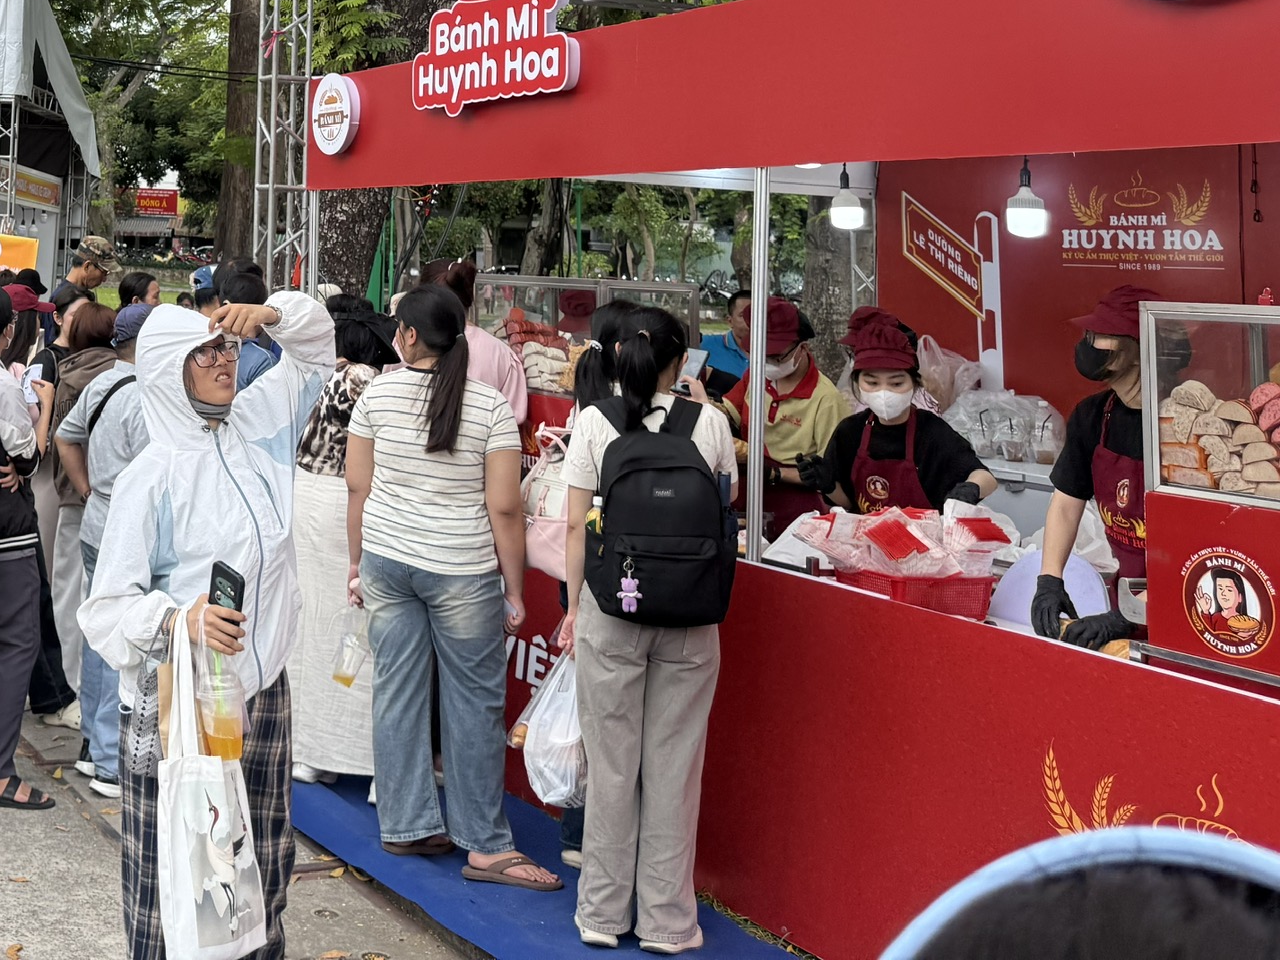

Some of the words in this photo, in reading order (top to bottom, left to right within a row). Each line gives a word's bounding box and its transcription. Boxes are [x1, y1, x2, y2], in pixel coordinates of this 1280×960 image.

[435, 11, 499, 56] Bánh
[418, 51, 497, 103] Huynh
[504, 47, 560, 84] Hoa
[1109, 212, 1147, 226] BÁNH
[1150, 212, 1167, 226] MÌ
[1062, 229, 1155, 250] HUYNH
[1163, 229, 1224, 250] HOA
[913, 230, 926, 250] LÊ
[928, 242, 945, 268] THỊ
[947, 258, 978, 291] RIÊNG
[1119, 262, 1141, 270] SINCE
[1144, 263, 1161, 271] 1989
[1121, 252, 1139, 261] VIỆT
[1205, 556, 1232, 568] BÁNH
[1233, 561, 1246, 573] MÌ
[1203, 631, 1237, 654] HUYNH
[1238, 642, 1258, 654] HOA
